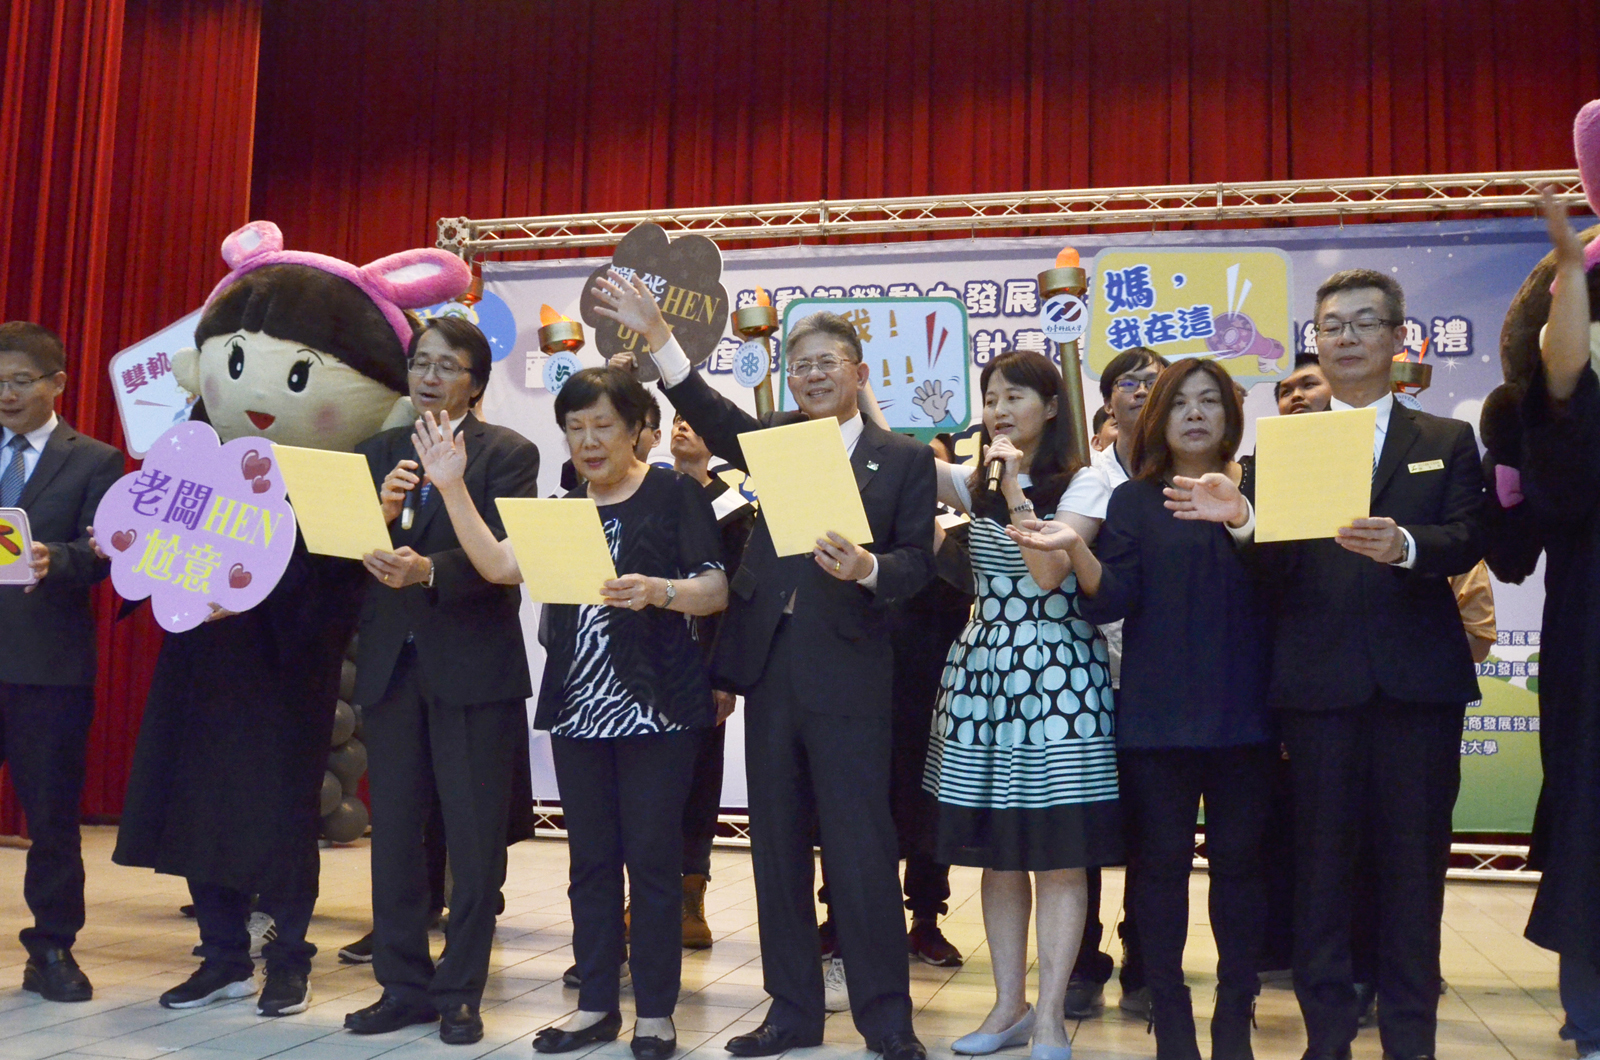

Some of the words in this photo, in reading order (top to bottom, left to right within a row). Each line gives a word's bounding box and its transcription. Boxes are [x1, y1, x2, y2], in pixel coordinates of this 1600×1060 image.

[1106, 304, 1216, 350] 我在這
[121, 351, 172, 394] 雙軌
[131, 528, 223, 594] 尬意
[1463, 716, 1540, 731] 商發展投資
